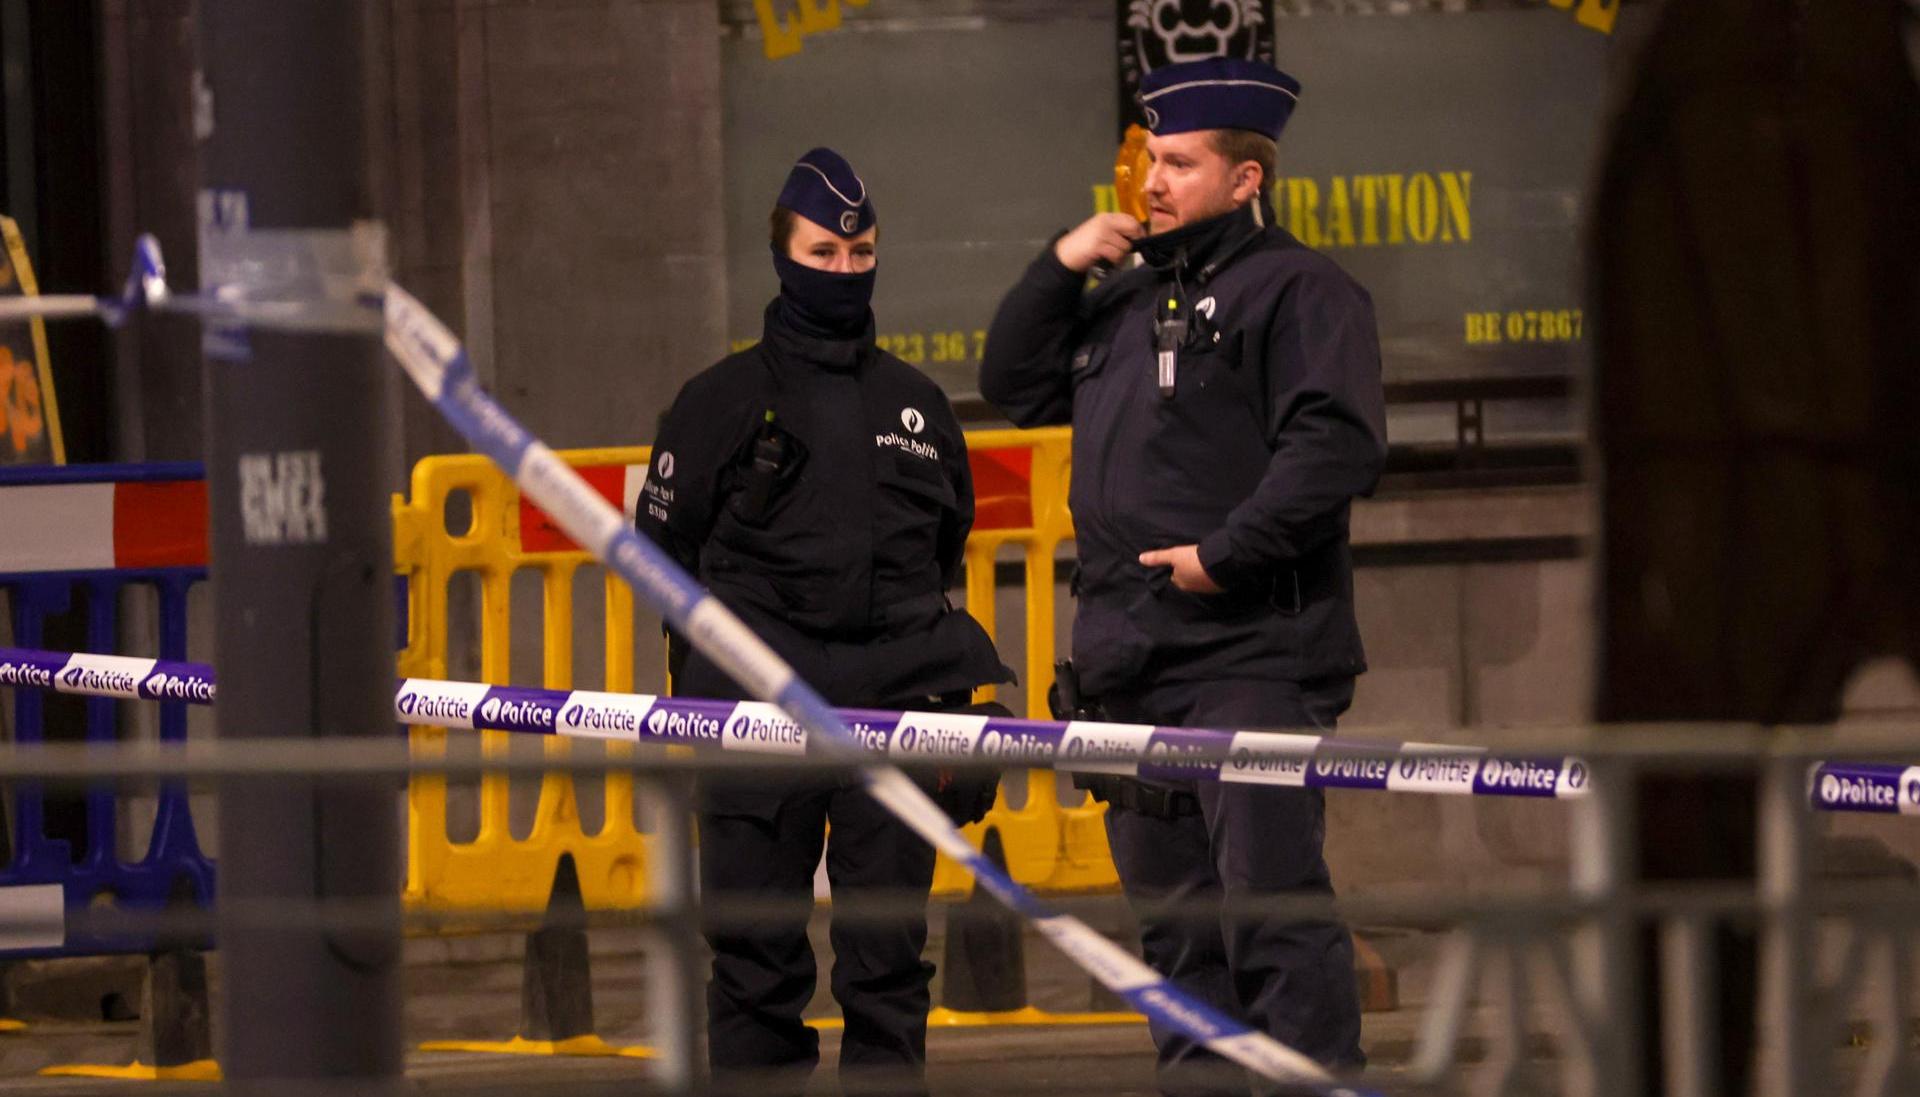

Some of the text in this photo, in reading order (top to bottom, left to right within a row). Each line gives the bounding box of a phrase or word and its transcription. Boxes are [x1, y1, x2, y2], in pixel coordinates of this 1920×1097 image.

[1465, 312, 1500, 344] BE
[0, 662, 217, 699] Police Politie Police
[417, 694, 468, 719] Politie
[501, 700, 552, 726] Police
[584, 705, 635, 731] Politie
[668, 711, 719, 738] Police
[751, 718, 801, 743] Politie
[851, 723, 887, 750] lice
[918, 728, 970, 755] Politie
[1002, 733, 1053, 757] Police
[1333, 757, 1386, 780] Police
[1501, 760, 1555, 788] Police
[1841, 777, 1895, 805] Police
